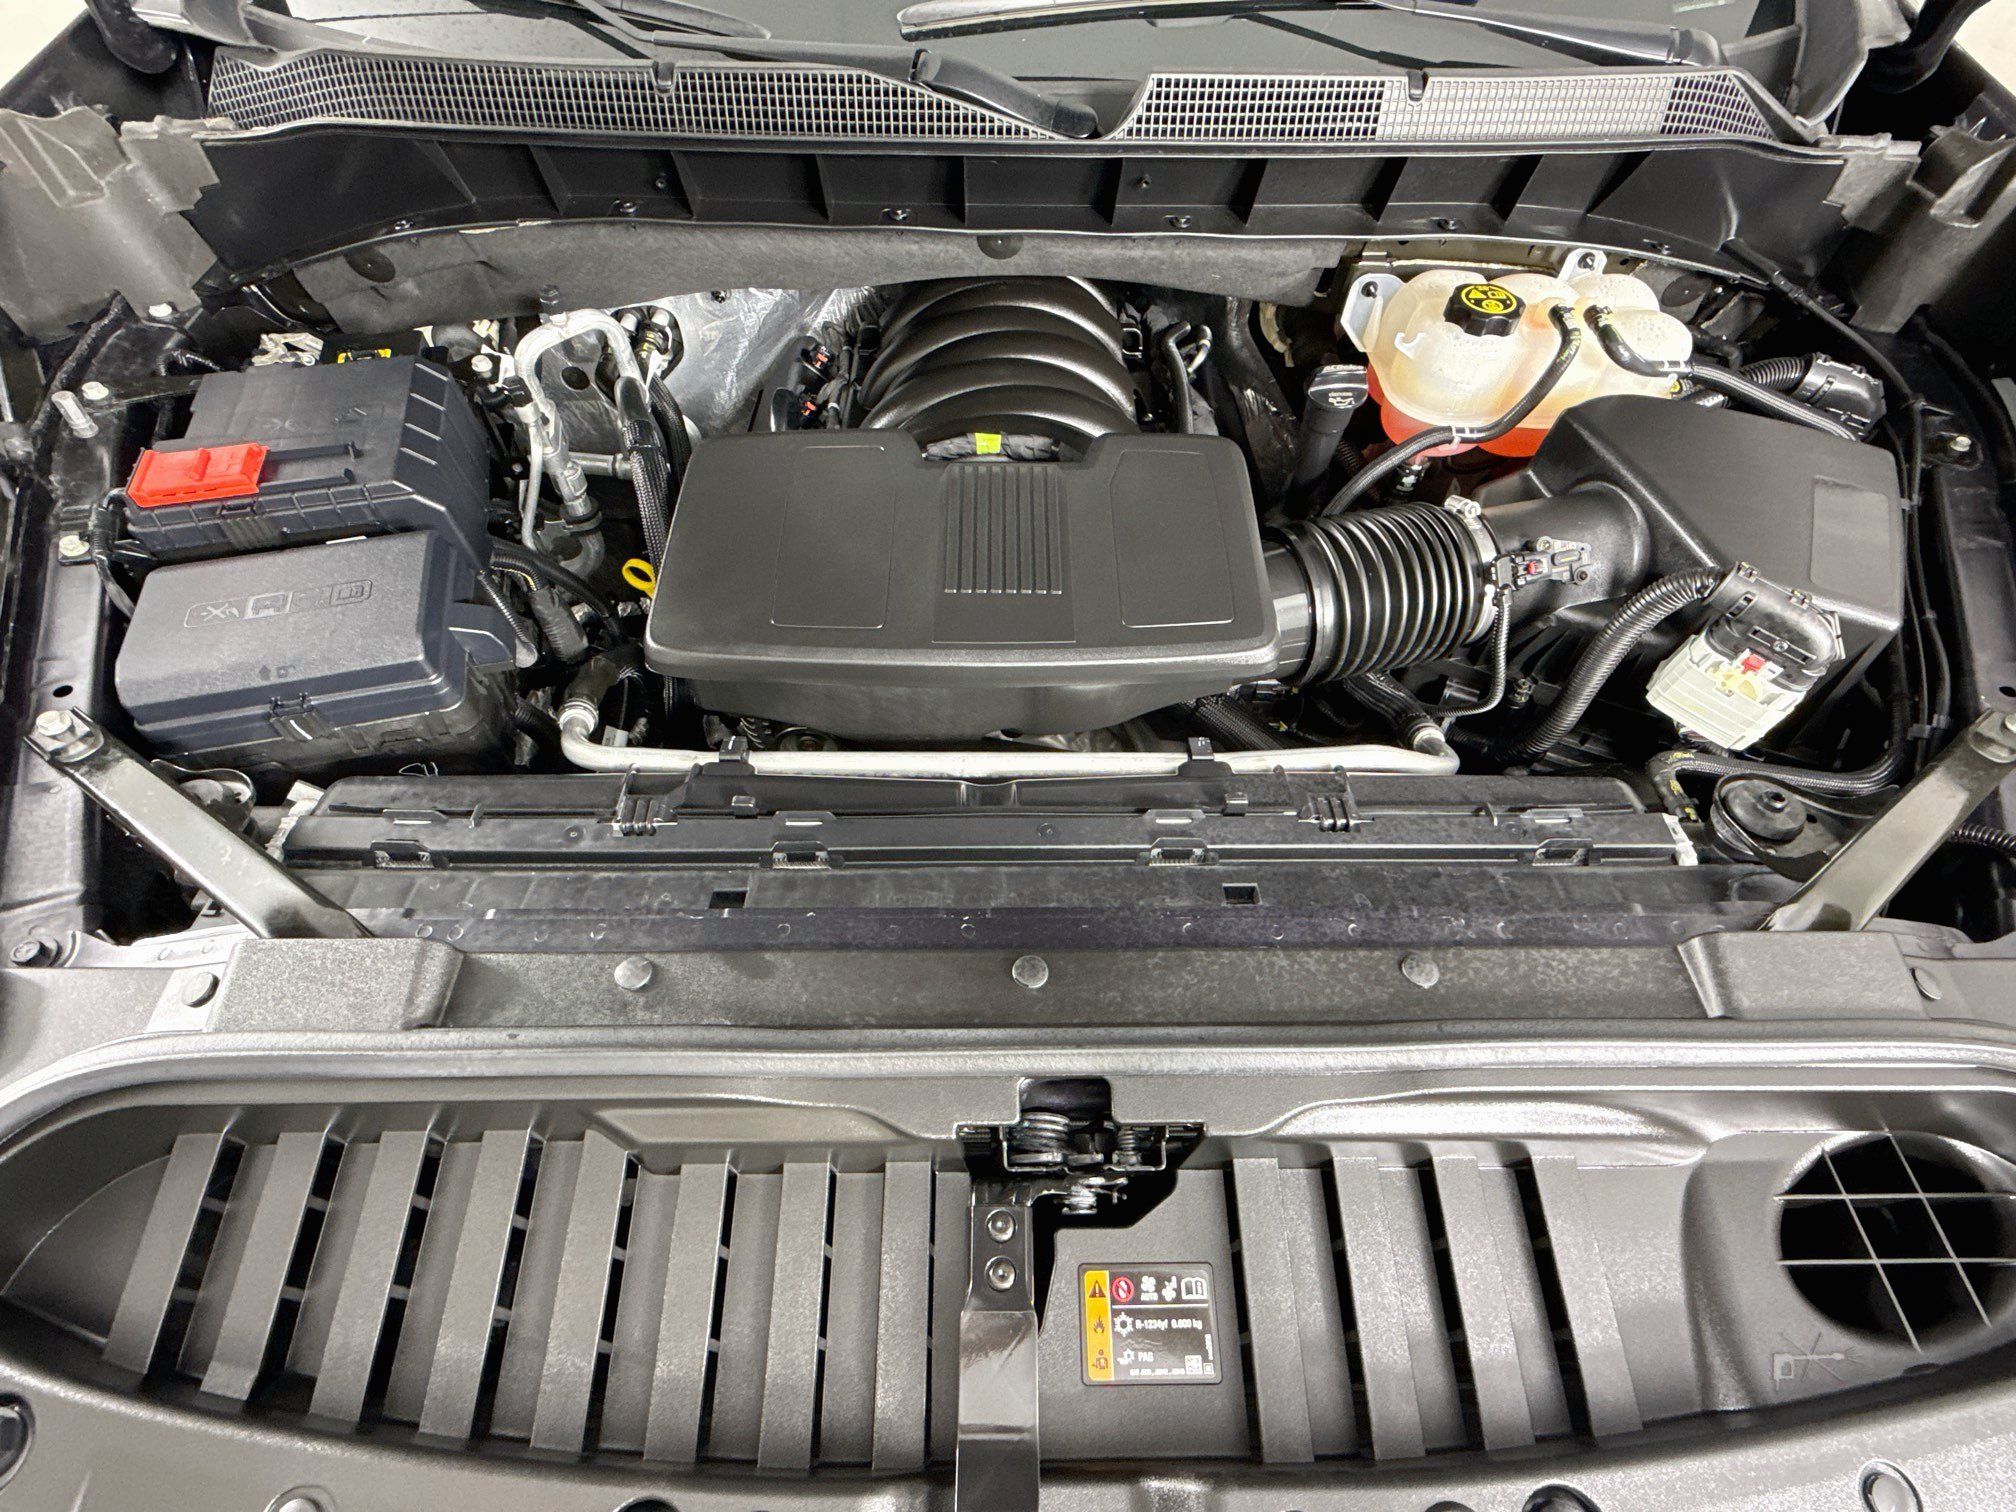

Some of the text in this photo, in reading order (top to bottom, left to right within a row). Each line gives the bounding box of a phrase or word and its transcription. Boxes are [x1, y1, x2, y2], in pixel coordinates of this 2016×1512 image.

[1140, 1292, 1158, 1301] AUTO
[1135, 1319, 1168, 1330] R-1234yf
[1193, 1318, 1203, 1330] kg
[1138, 1351, 1154, 1362] PAG
